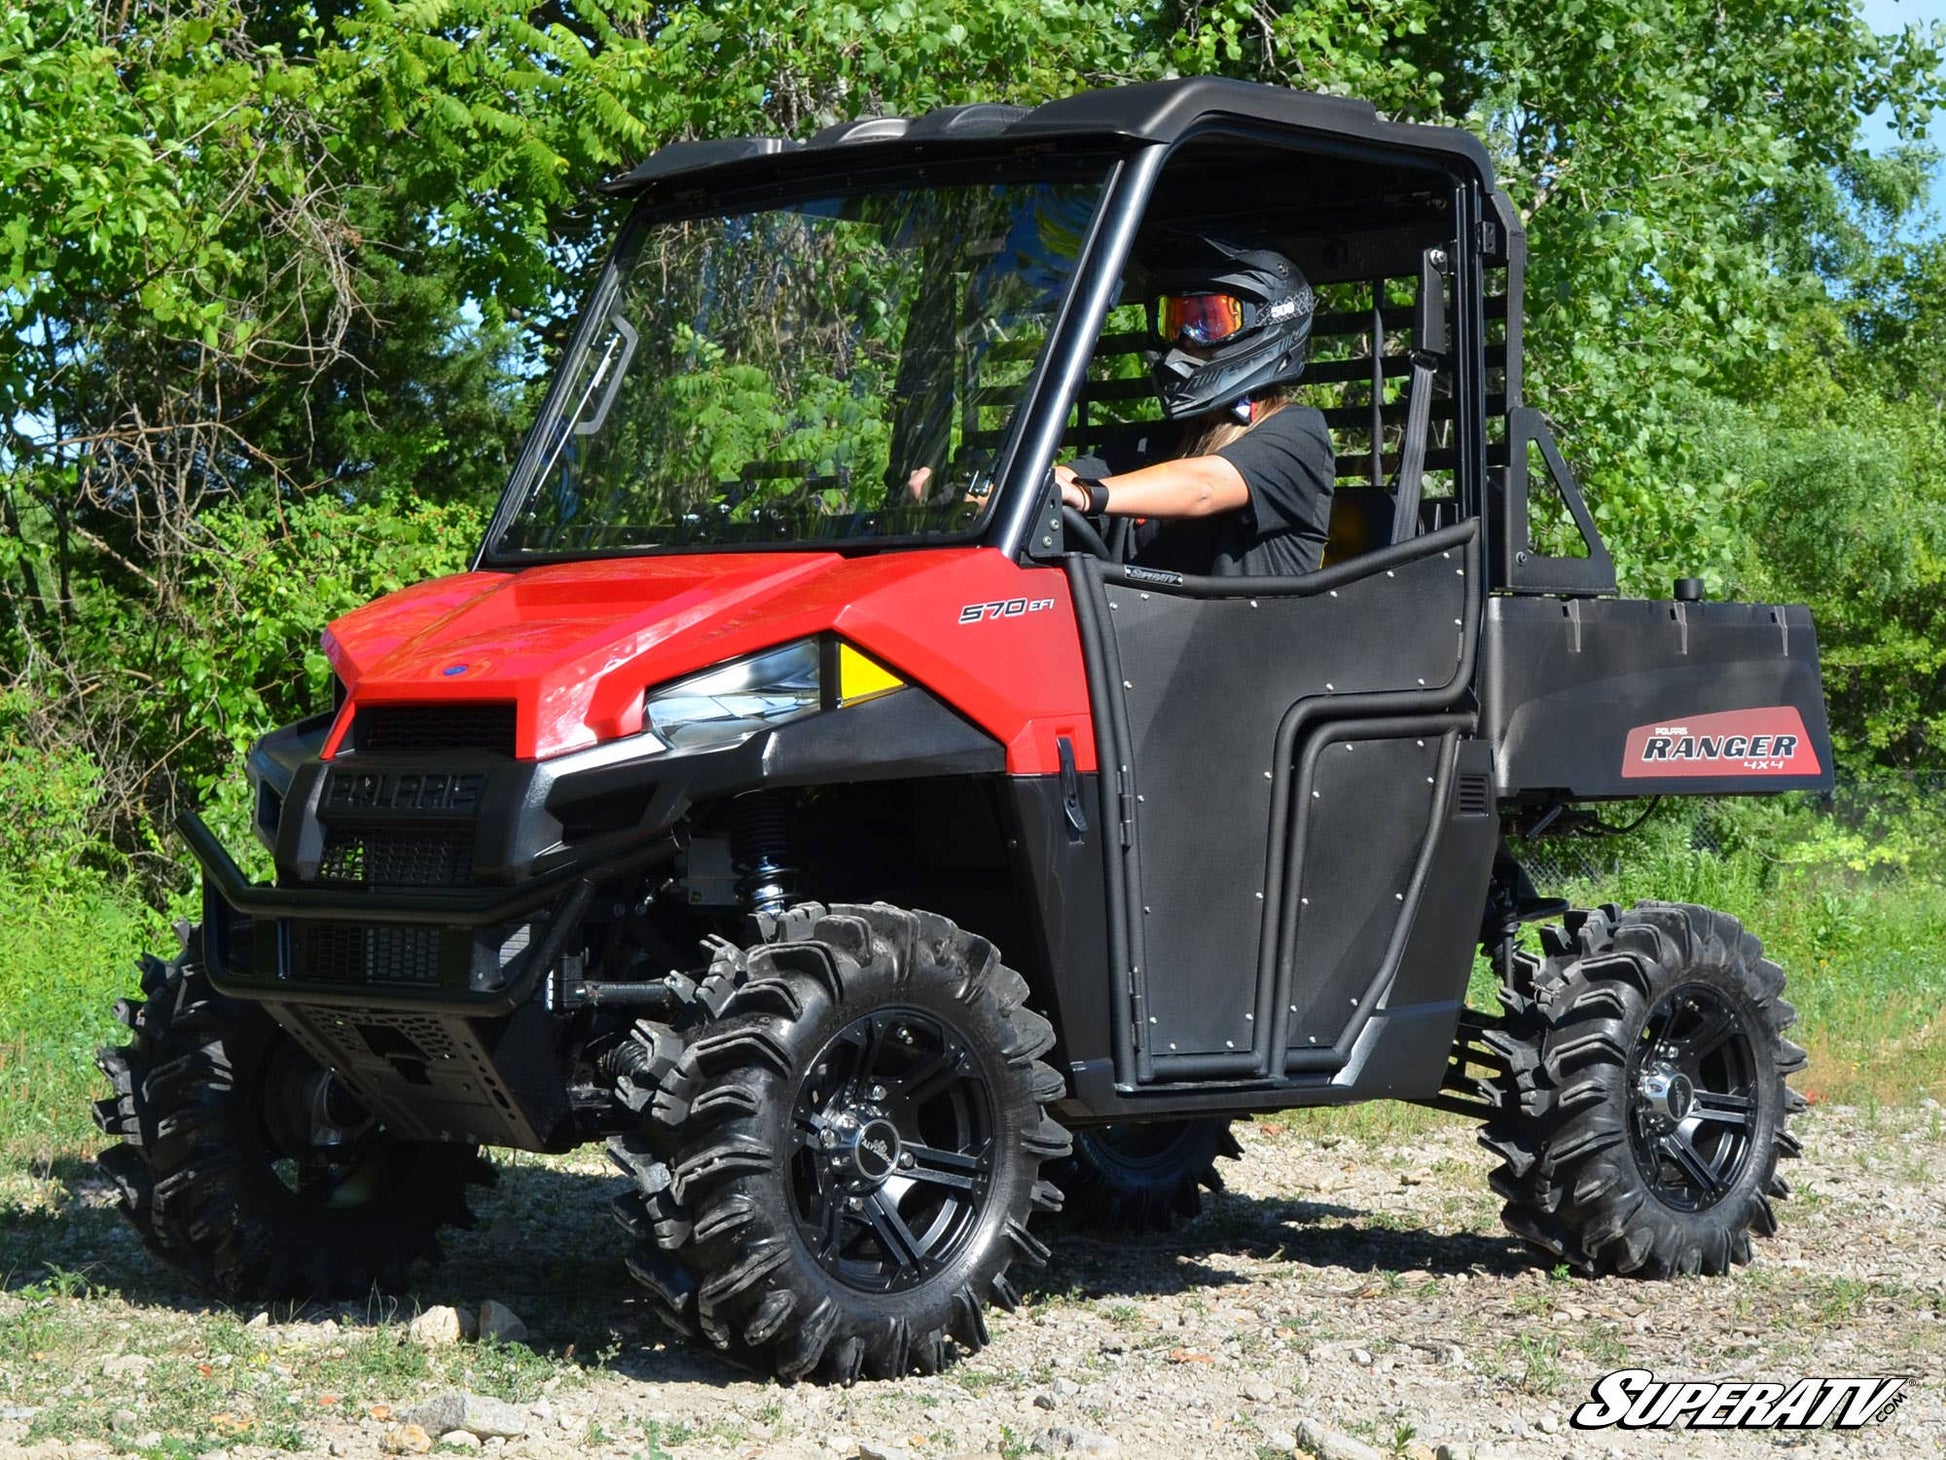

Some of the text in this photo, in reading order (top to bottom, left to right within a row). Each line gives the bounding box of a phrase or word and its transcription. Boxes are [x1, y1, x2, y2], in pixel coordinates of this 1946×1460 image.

[958, 597, 1056, 625] 570 EFI
[1655, 726, 1689, 736] POLARIS
[1641, 734, 1799, 762] RANGER
